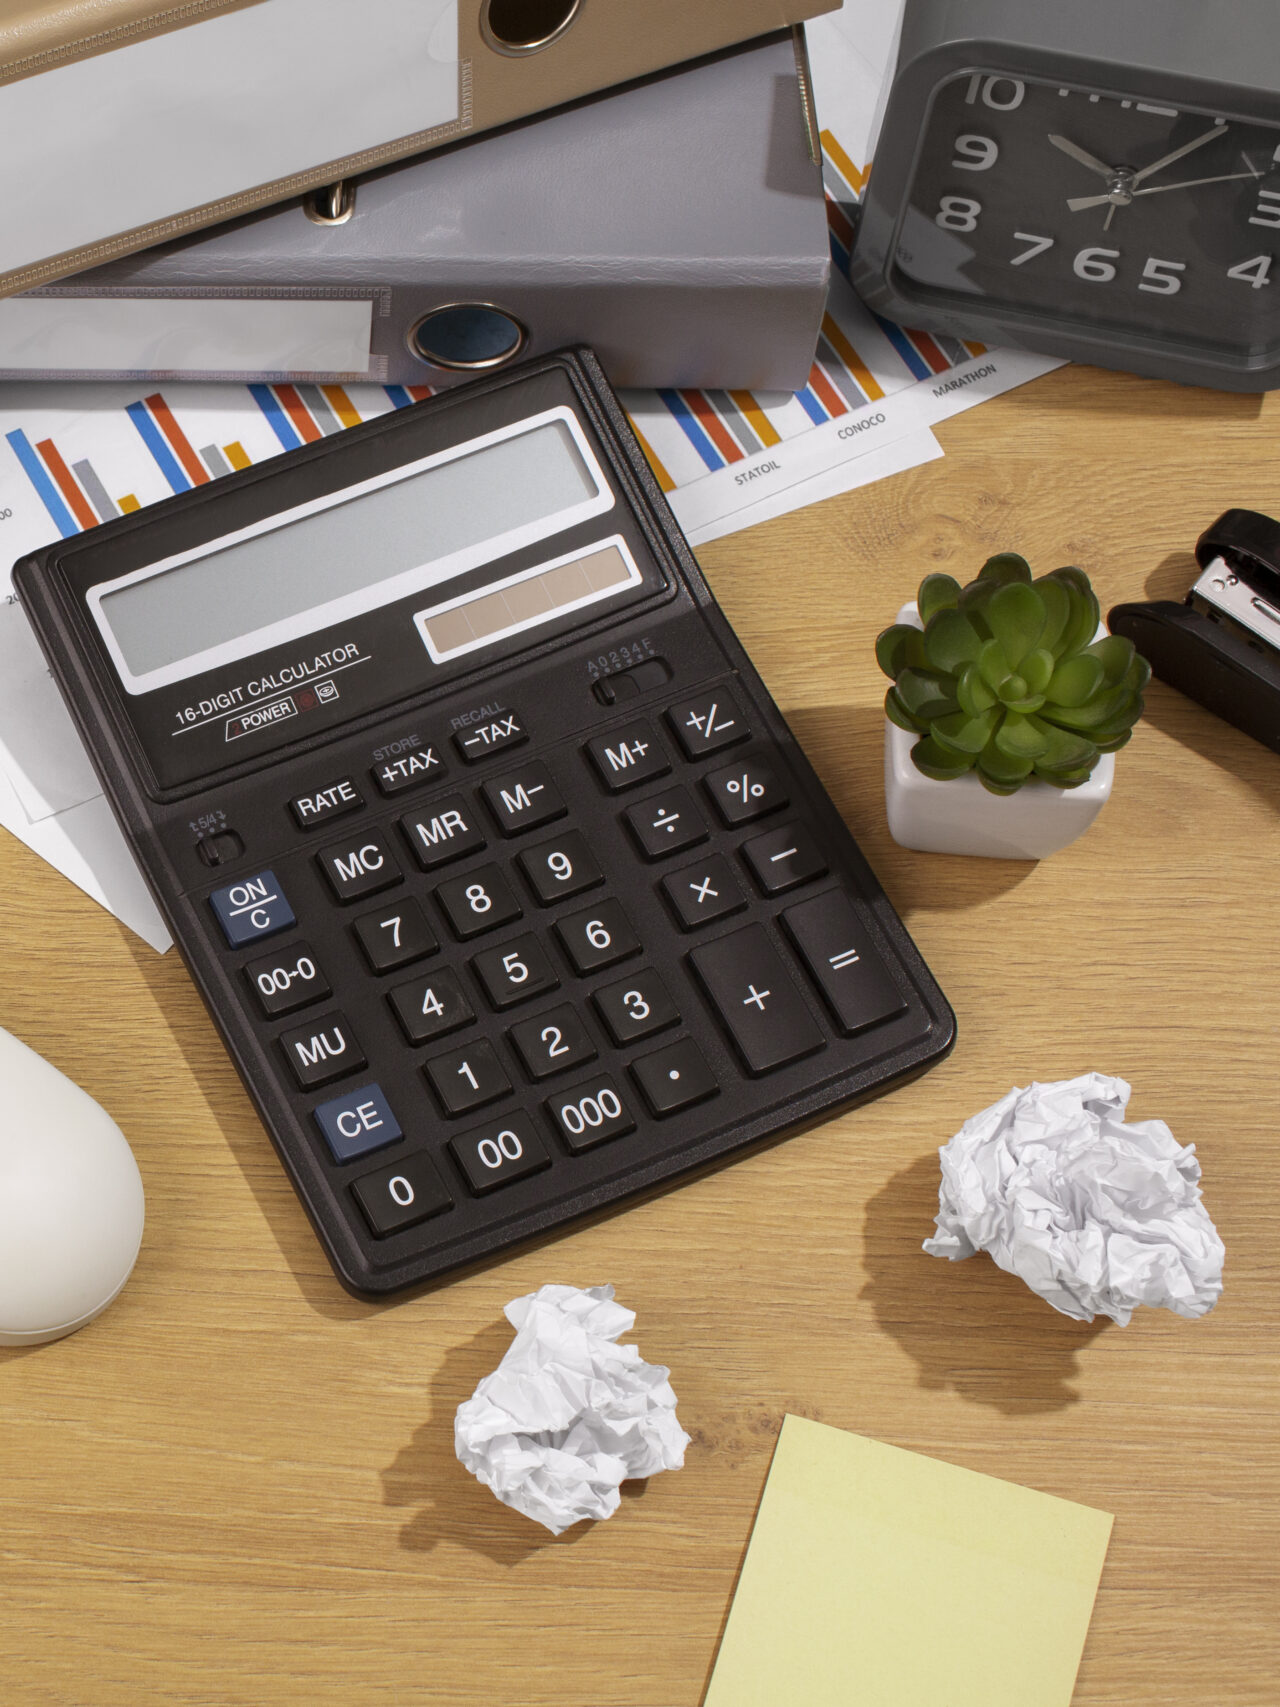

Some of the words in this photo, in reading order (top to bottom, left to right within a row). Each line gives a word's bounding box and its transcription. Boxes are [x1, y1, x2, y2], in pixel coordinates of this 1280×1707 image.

[964, 75, 1025, 111] 10
[951, 134, 999, 172] 9
[936, 196, 982, 232] 8
[1010, 231, 1054, 266] 7
[1073, 247, 1120, 282] 6
[1137, 257, 1186, 295] 5
[1226, 255, 1272, 289] 4
[932, 363, 997, 399] MARATHON
[837, 413, 886, 440] CONOCO
[734, 460, 781, 486] STATOIL
[176, 687, 243, 725] 16-DIGIT
[248, 643, 359, 696] CALCULATOR
[241, 702, 291, 730] POWER
[450, 702, 506, 730] RECALL
[373, 734, 421, 762] STORE
[604, 740, 649, 771] M+
[382, 748, 439, 782] +TAX
[297, 781, 357, 817] RATE
[726, 773, 765, 803] %
[415, 810, 469, 847] MR
[333, 844, 384, 882] MC
[547, 851, 573, 881] 9
[227, 877, 269, 907] ON
[465, 884, 492, 913] 8
[250, 908, 270, 929] C
[379, 916, 401, 948] 7
[585, 920, 611, 949] 6
[502, 952, 529, 983] 5
[422, 988, 444, 1017] 4
[623, 990, 650, 1020] 3
[294, 1026, 346, 1067] MU
[540, 1026, 570, 1058] 2
[457, 1061, 480, 1090] 1
[336, 1100, 384, 1138] CE
[561, 1088, 622, 1134] 000
[477, 1130, 523, 1169] 00
[388, 1175, 415, 1206] 0
